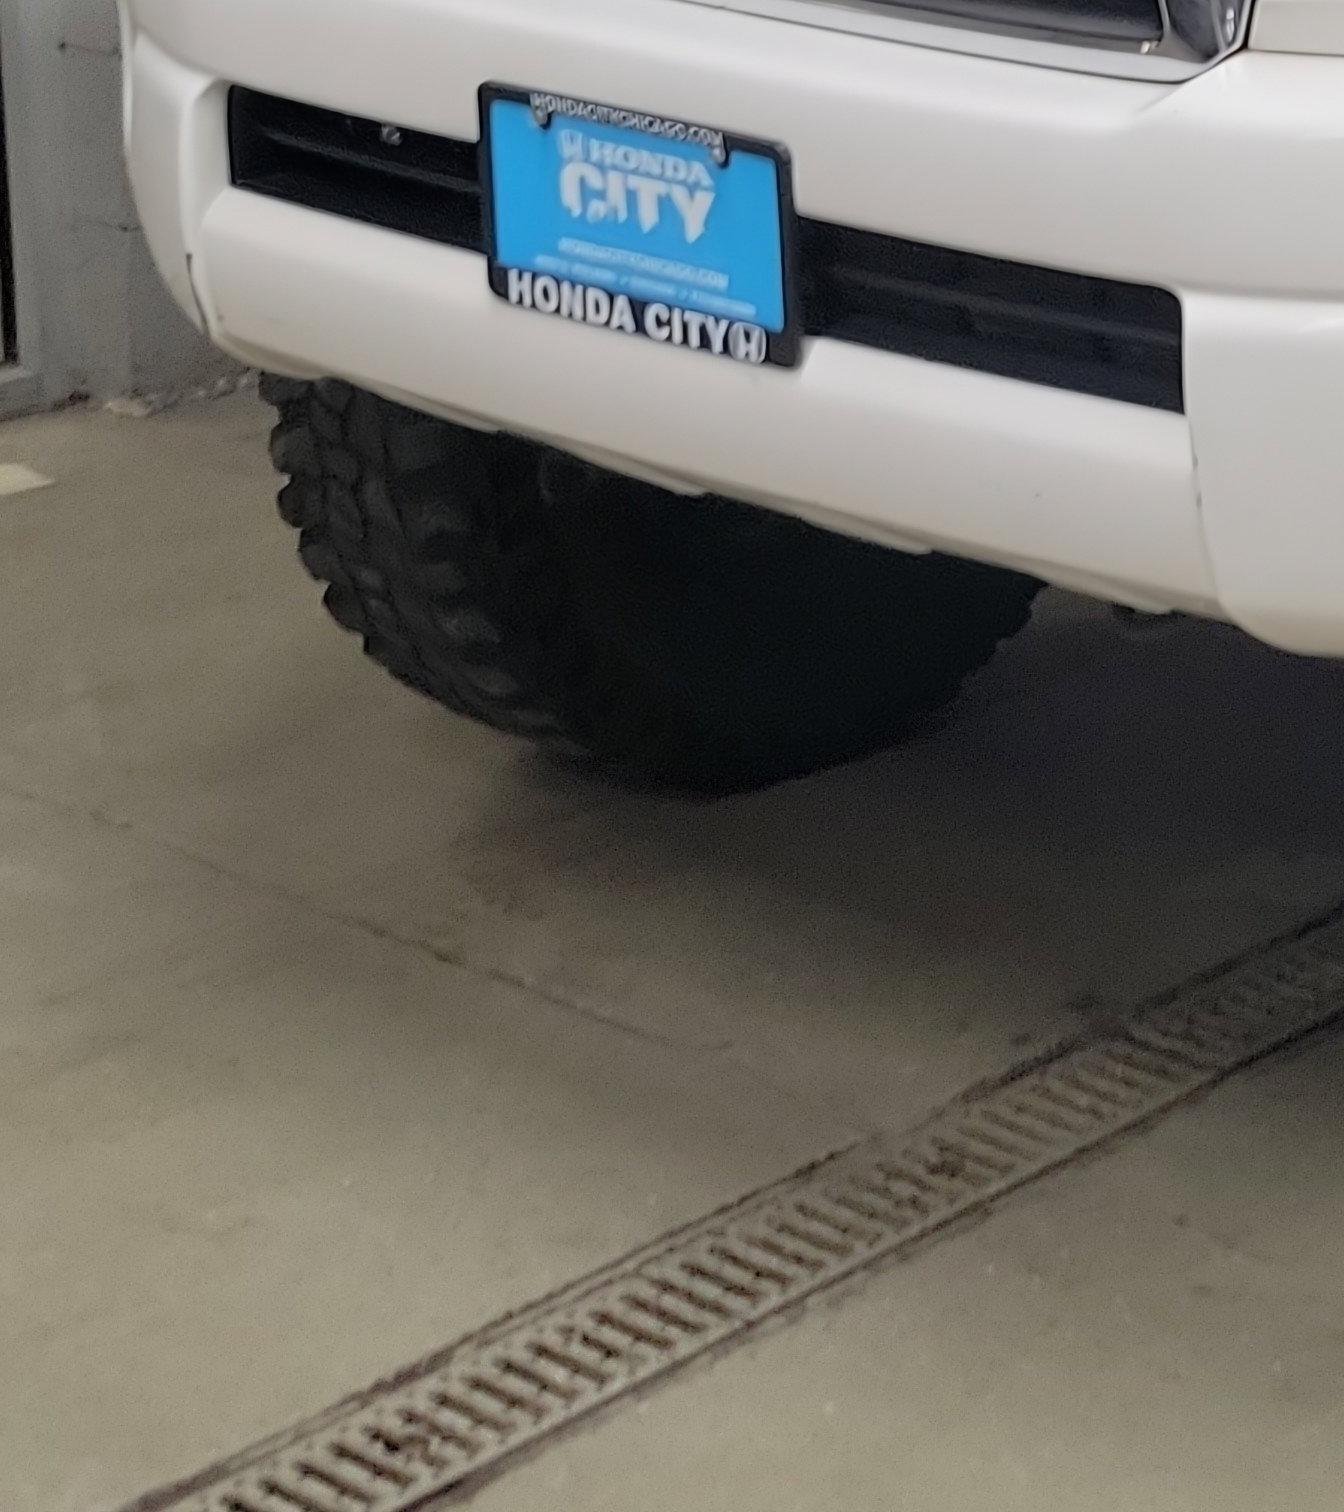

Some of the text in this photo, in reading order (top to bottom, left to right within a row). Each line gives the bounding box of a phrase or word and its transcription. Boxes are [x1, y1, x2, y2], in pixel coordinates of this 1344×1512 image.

[559, 161, 716, 244] CITY
[588, 138, 715, 187] HONDA
[507, 267, 637, 334] HONDA
[643, 302, 730, 355] CITY
